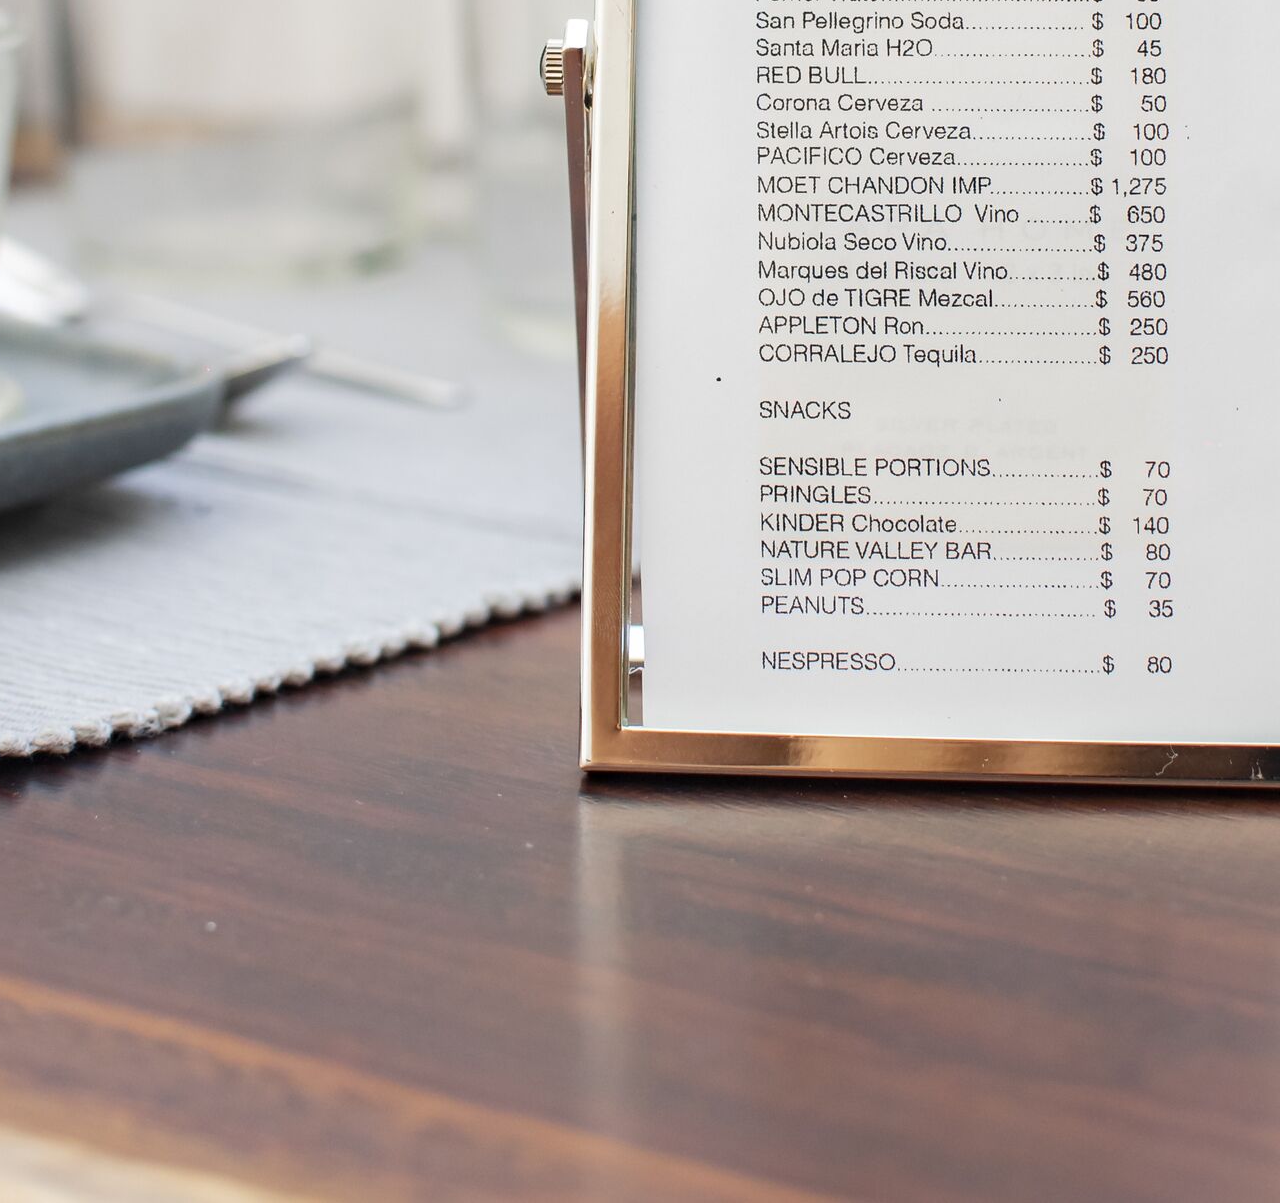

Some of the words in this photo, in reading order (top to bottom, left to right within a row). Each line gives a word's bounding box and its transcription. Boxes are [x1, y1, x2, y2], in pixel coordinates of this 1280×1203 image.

[755, 10, 795, 30] San
[802, 10, 904, 35] Pellegrino
[910, 11, 965, 30] Soda
[1091, 11, 1104, 31] $
[1125, 12, 1162, 31] 100
[755, 37, 815, 57] Santa
[821, 38, 879, 57] Maria
[886, 38, 933, 57] H2O
[1091, 38, 1105, 59] $
[1136, 39, 1162, 58] 45
[756, 65, 802, 85] RED
[807, 65, 869, 86] BULL
[1090, 66, 1103, 86] $
[1130, 66, 1167, 85] 180
[756, 92, 832, 112] Corona
[837, 93, 924, 112] Cerveza
[1090, 93, 1104, 114] $
[1140, 94, 1167, 113] 50
[756, 120, 813, 140] Stella
[818, 120, 879, 140] Artois
[885, 120, 972, 140] Cerveza
[1092, 122, 1106, 142] $
[1132, 122, 1170, 142] 100
[757, 146, 863, 166] PACIFICO
[869, 146, 956, 166] Cerveza
[1090, 148, 1103, 168] $
[1129, 147, 1167, 167] 100
[757, 175, 822, 194] MOET
[827, 175, 944, 195] CHANDON
[952, 175, 991, 195] IMP
[1090, 177, 1104, 197] $
[1111, 177, 1167, 198] 1,275
[757, 203, 963, 223] MONTECASTRILLO
[974, 203, 1020, 224] Vino
[1088, 204, 1102, 225] $
[1126, 204, 1166, 224] 650
[758, 230, 837, 251] Nubiola
[843, 232, 898, 252] Seco
[901, 231, 948, 252] Vino
[1093, 233, 1106, 254] $
[1125, 233, 1164, 253] 375
[758, 259, 849, 284] Marques
[855, 260, 888, 280] del
[894, 260, 957, 281] Riscal
[962, 260, 1008, 281] Vino
[1097, 261, 1110, 282] $
[1128, 262, 1167, 282] 480
[758, 287, 806, 307] OJO
[811, 288, 839, 307] de
[843, 287, 912, 308] TIGRE
[918, 288, 993, 308] Mezcal
[1095, 288, 1109, 310] $
[1127, 290, 1166, 309] 560
[758, 315, 877, 336] APPLETON
[884, 315, 924, 336] Ron
[1098, 316, 1111, 337] $
[1129, 317, 1169, 336] 250
[758, 343, 897, 364] CORRALEJO
[902, 343, 977, 369] Tequila
[1098, 344, 1112, 366] $
[1130, 346, 1169, 365] 250
[759, 400, 852, 420] SNACKS
[759, 456, 868, 477] SENSIBLE
[875, 457, 991, 477] PORTIONS
[1099, 459, 1113, 479] $
[1144, 460, 1171, 479] 70
[759, 484, 872, 505] PRINGLES
[1097, 486, 1111, 508] $
[1142, 488, 1168, 507] 70
[760, 511, 845, 533] KINDER
[851, 513, 957, 534] Chocolate
[1098, 515, 1112, 536] $
[1132, 516, 1170, 535] 140
[760, 539, 851, 560] NATURE
[854, 540, 939, 560] VALLEY
[945, 541, 992, 560] BAR
[1100, 541, 1114, 562] $
[1145, 542, 1171, 562] 80
[760, 567, 812, 587] SLIM
[820, 568, 867, 587] POP
[872, 568, 939, 588] CORN
[1099, 570, 1114, 591] $
[1145, 571, 1172, 590] 70
[761, 595, 865, 616] PEANUTS
[1103, 598, 1117, 619] $
[1148, 599, 1174, 619] 35
[761, 650, 896, 671] NESPRESSO
[1102, 654, 1115, 676] $
[1146, 655, 1173, 675] 80
